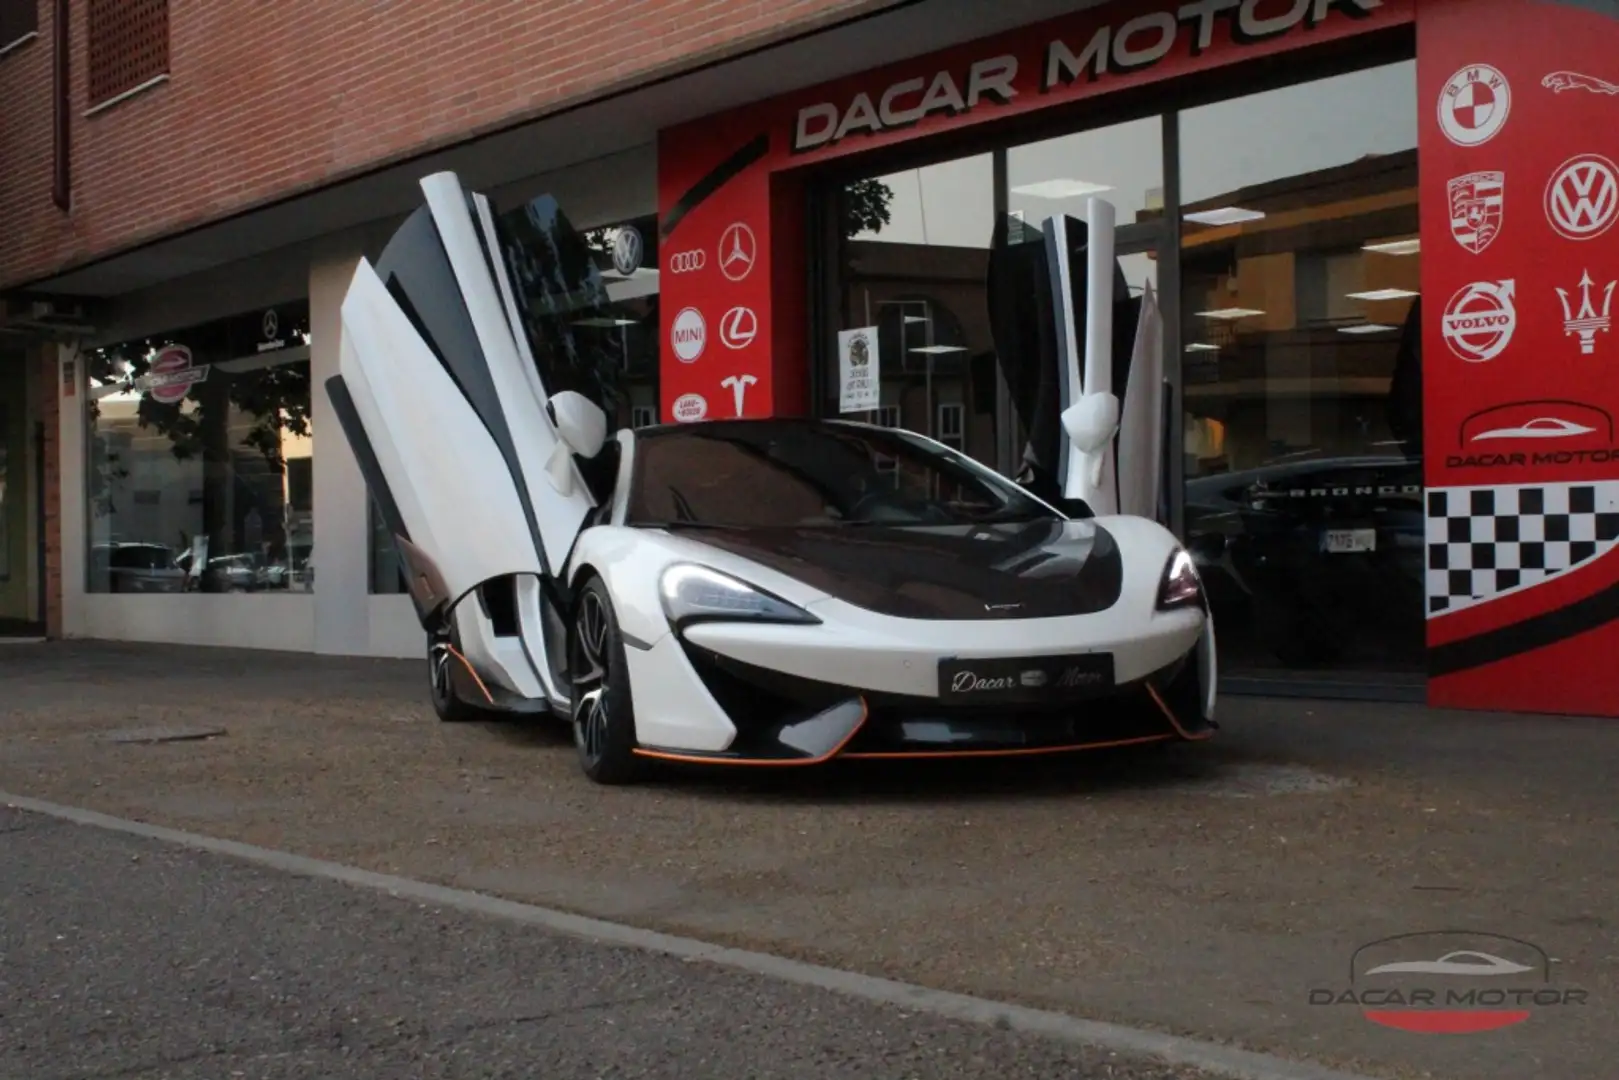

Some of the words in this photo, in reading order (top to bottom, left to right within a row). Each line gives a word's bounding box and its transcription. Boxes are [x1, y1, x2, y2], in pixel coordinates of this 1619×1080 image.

[1447, 69, 1502, 97] BMW
[794, 54, 1018, 151] DACAR
[1447, 314, 1510, 330] VOLVO
[675, 327, 702, 344] MINI
[1446, 453, 1525, 468] DACAR
[1290, 485, 1420, 497] BRONCO
[952, 670, 1016, 692] Dacar
